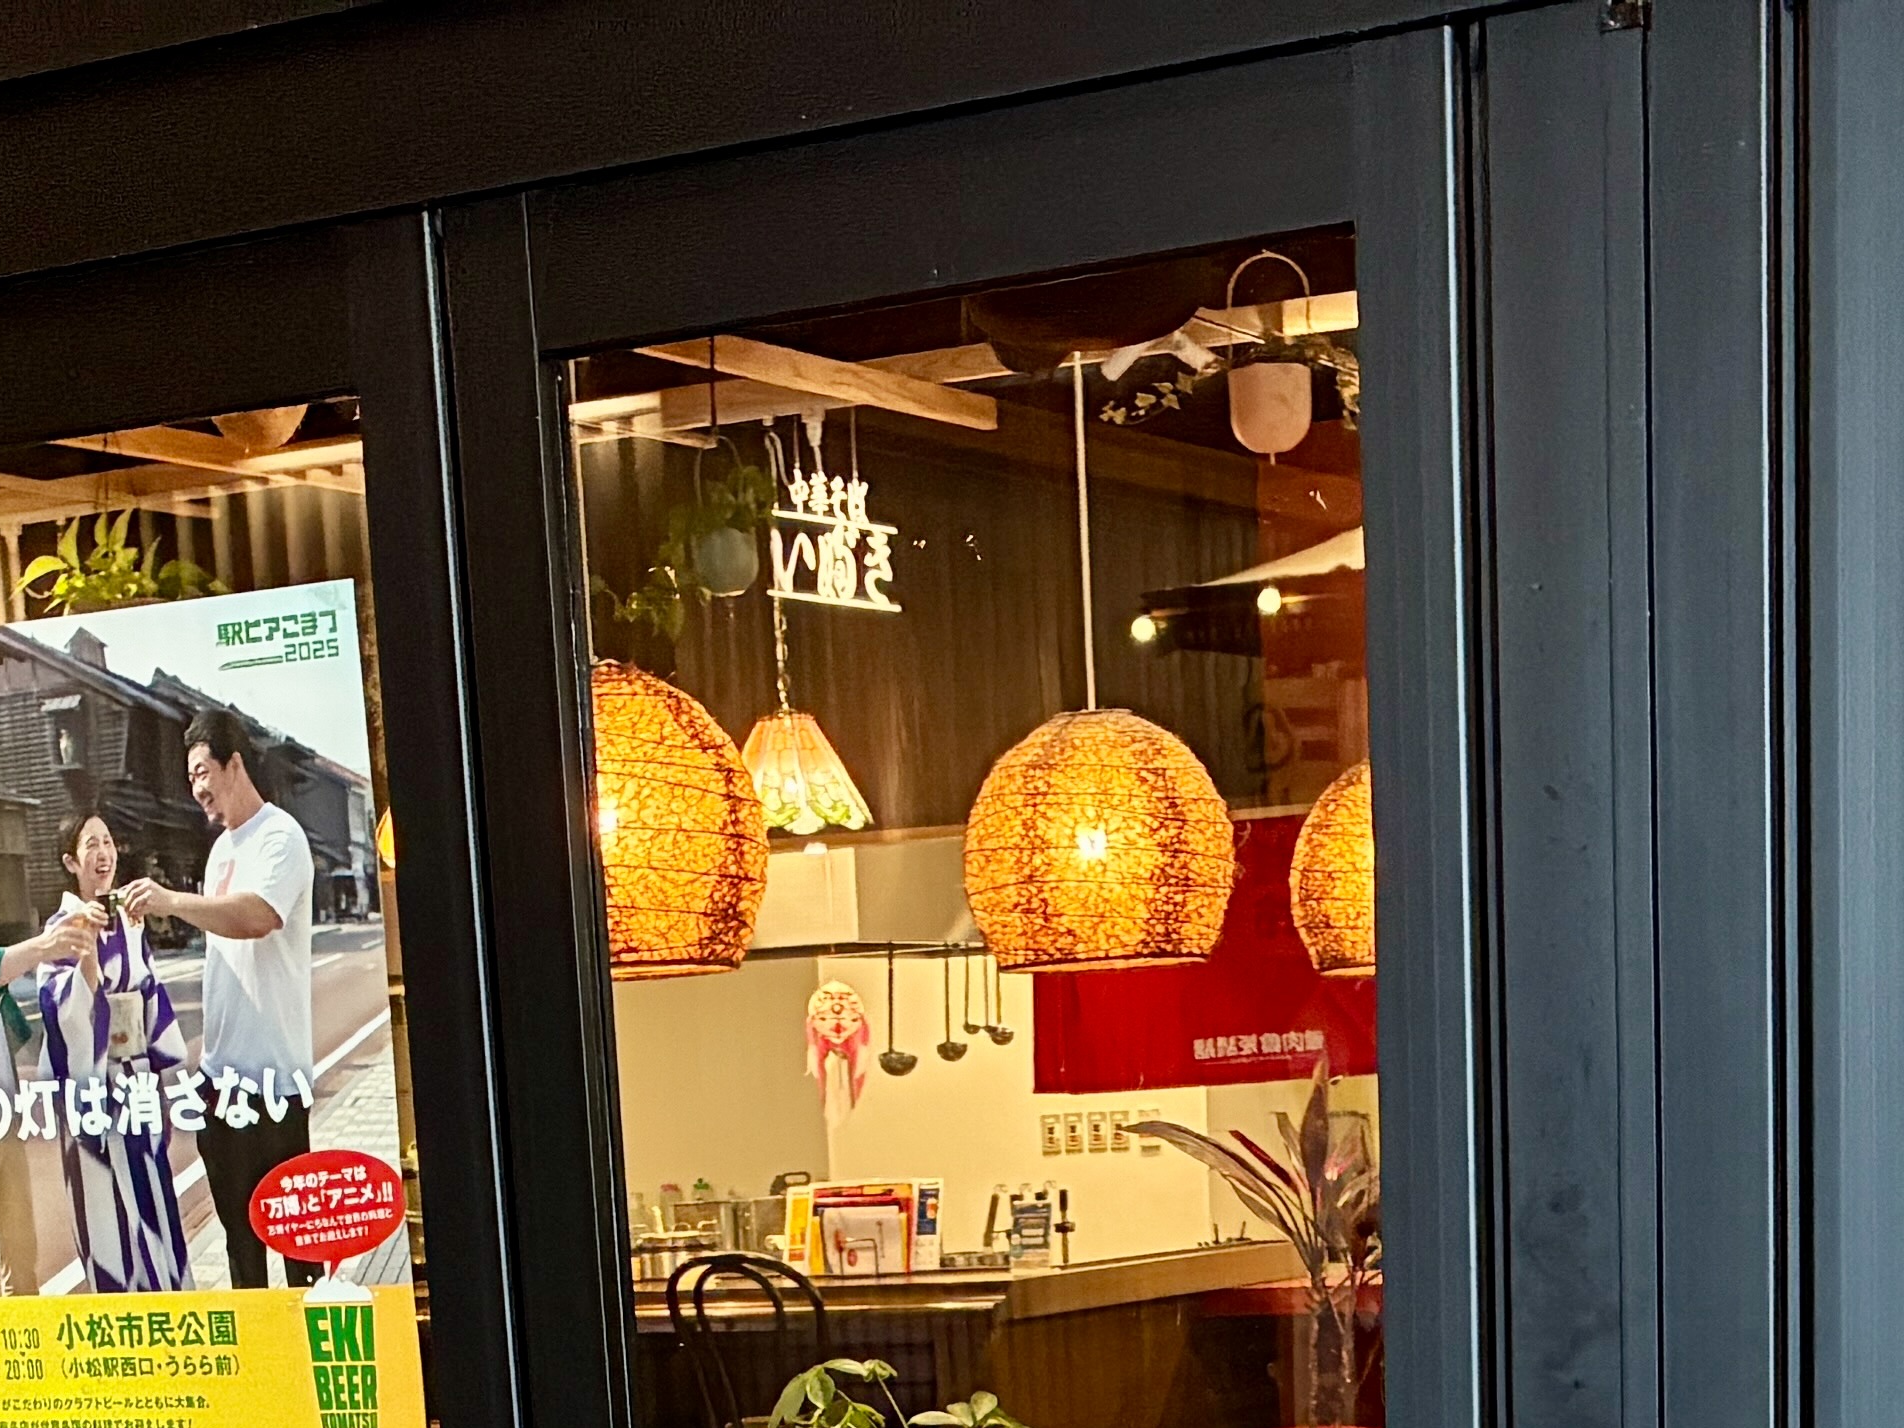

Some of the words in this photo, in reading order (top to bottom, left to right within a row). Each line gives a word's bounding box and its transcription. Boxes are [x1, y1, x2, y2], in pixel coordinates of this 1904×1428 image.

[284, 638, 339, 662] 2025
[280, 1165, 367, 1192] 今年のテーマは
[1, 1328, 39, 1350] 10:30
[57, 1310, 237, 1349] 小松市民公園
[304, 1305, 375, 1362] EKI
[5, 1359, 43, 1381] 20:00
[313, 1365, 378, 1410] BEER
